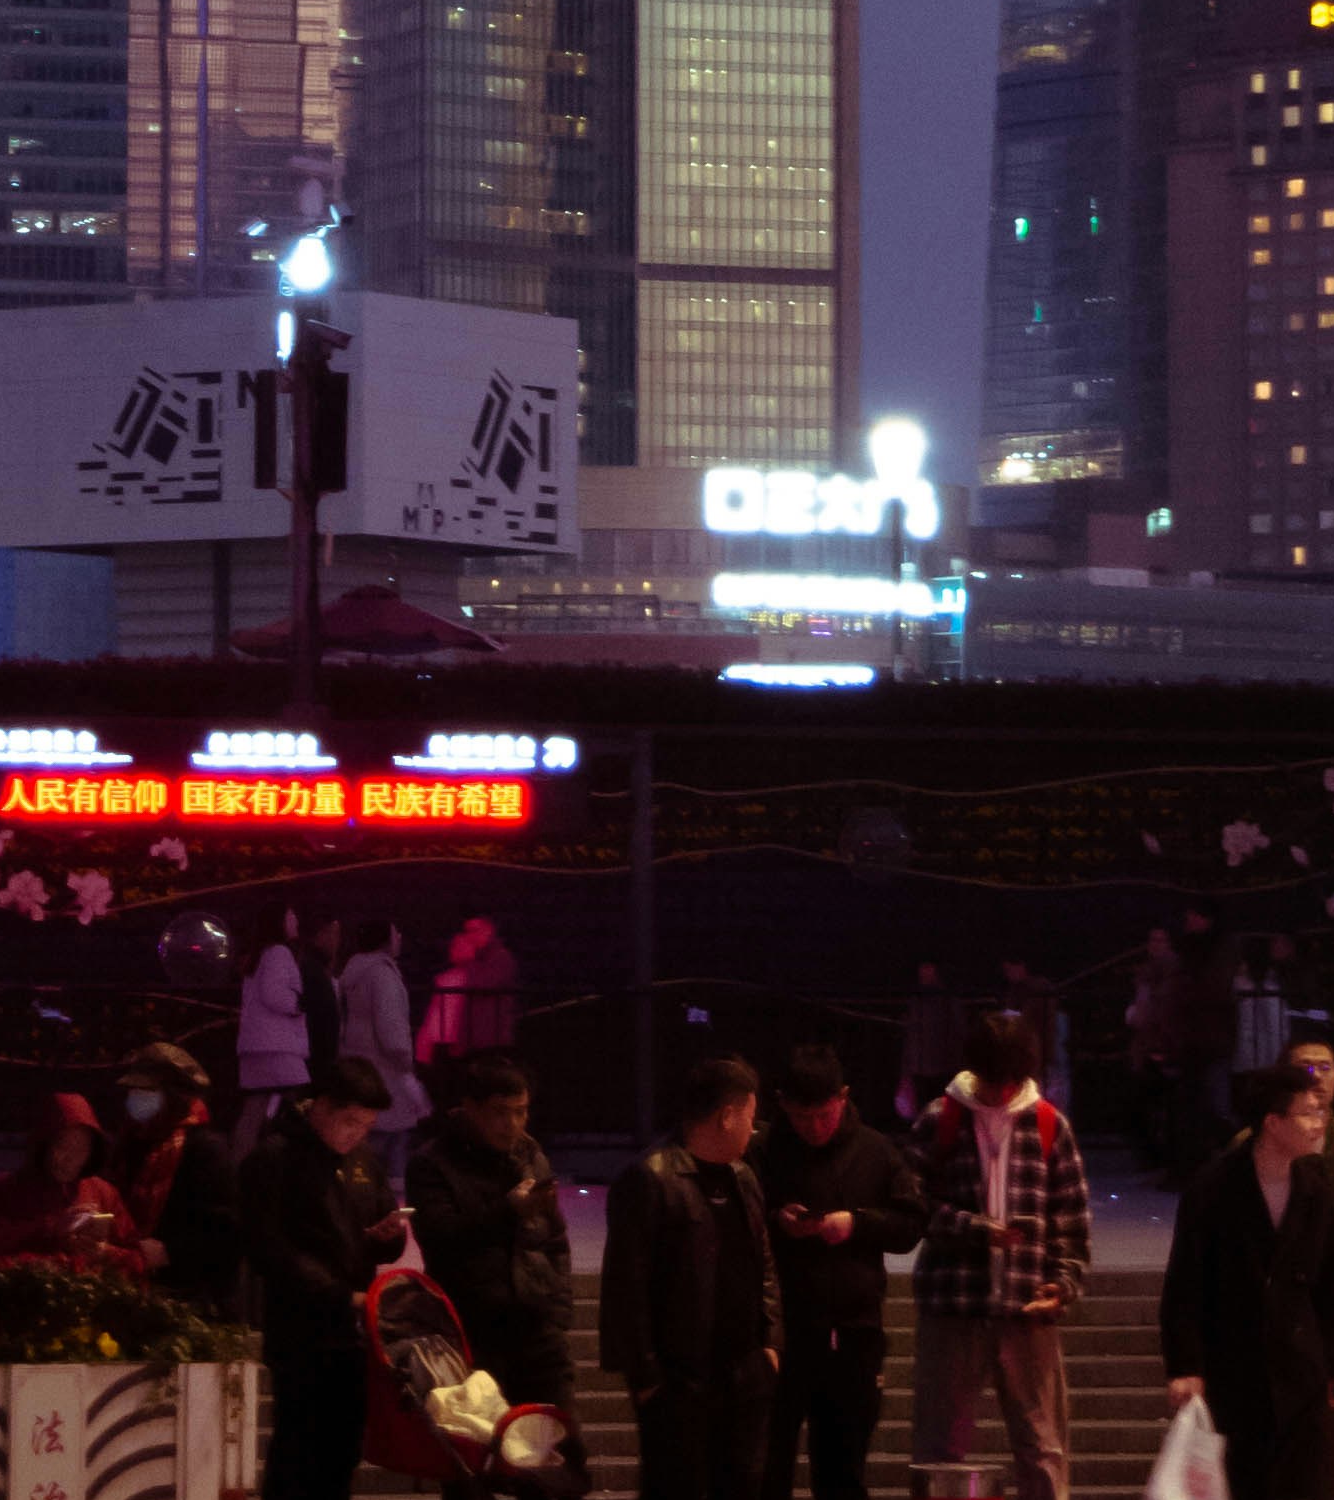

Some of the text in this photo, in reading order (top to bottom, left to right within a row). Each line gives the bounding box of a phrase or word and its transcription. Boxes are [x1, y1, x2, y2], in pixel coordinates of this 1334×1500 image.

[0, 777, 523, 818] 人民有信仰 国家有力量 民族有希望
